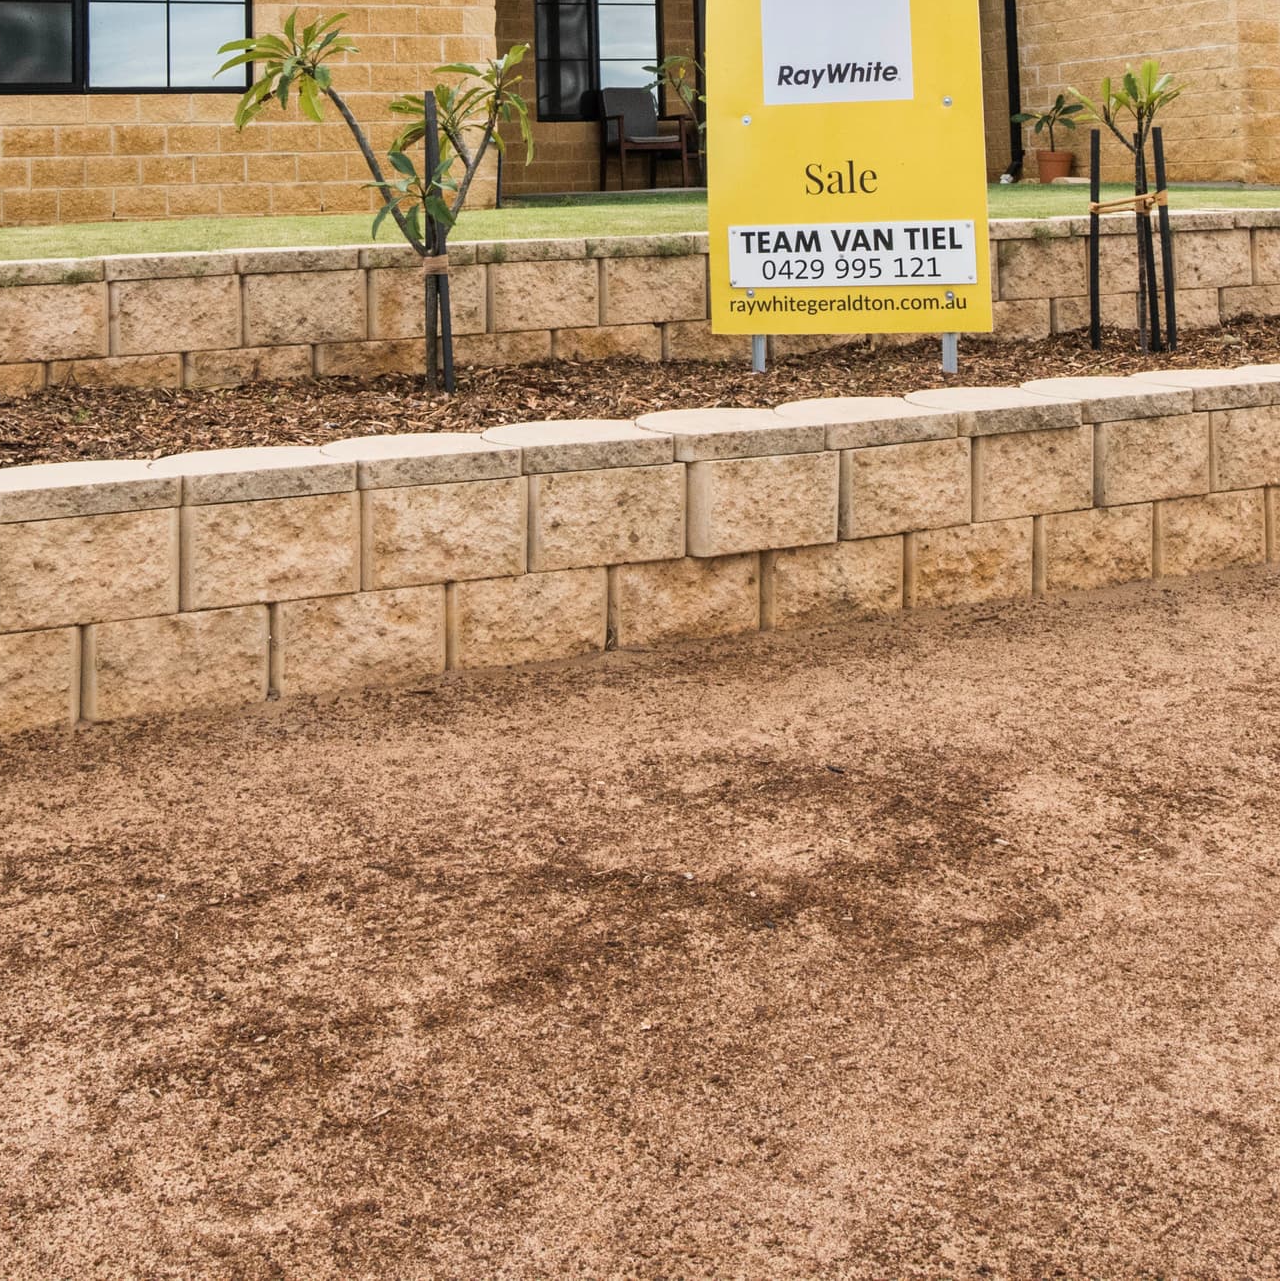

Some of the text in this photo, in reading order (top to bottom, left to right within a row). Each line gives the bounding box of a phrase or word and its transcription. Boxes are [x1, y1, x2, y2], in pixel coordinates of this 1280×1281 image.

[804, 160, 878, 196] Sale
[740, 226, 963, 254] TEAM VAN TIEL
[762, 256, 942, 280] 0429 995 121
[730, 295, 967, 316] raywhitegeraldton.com.au
